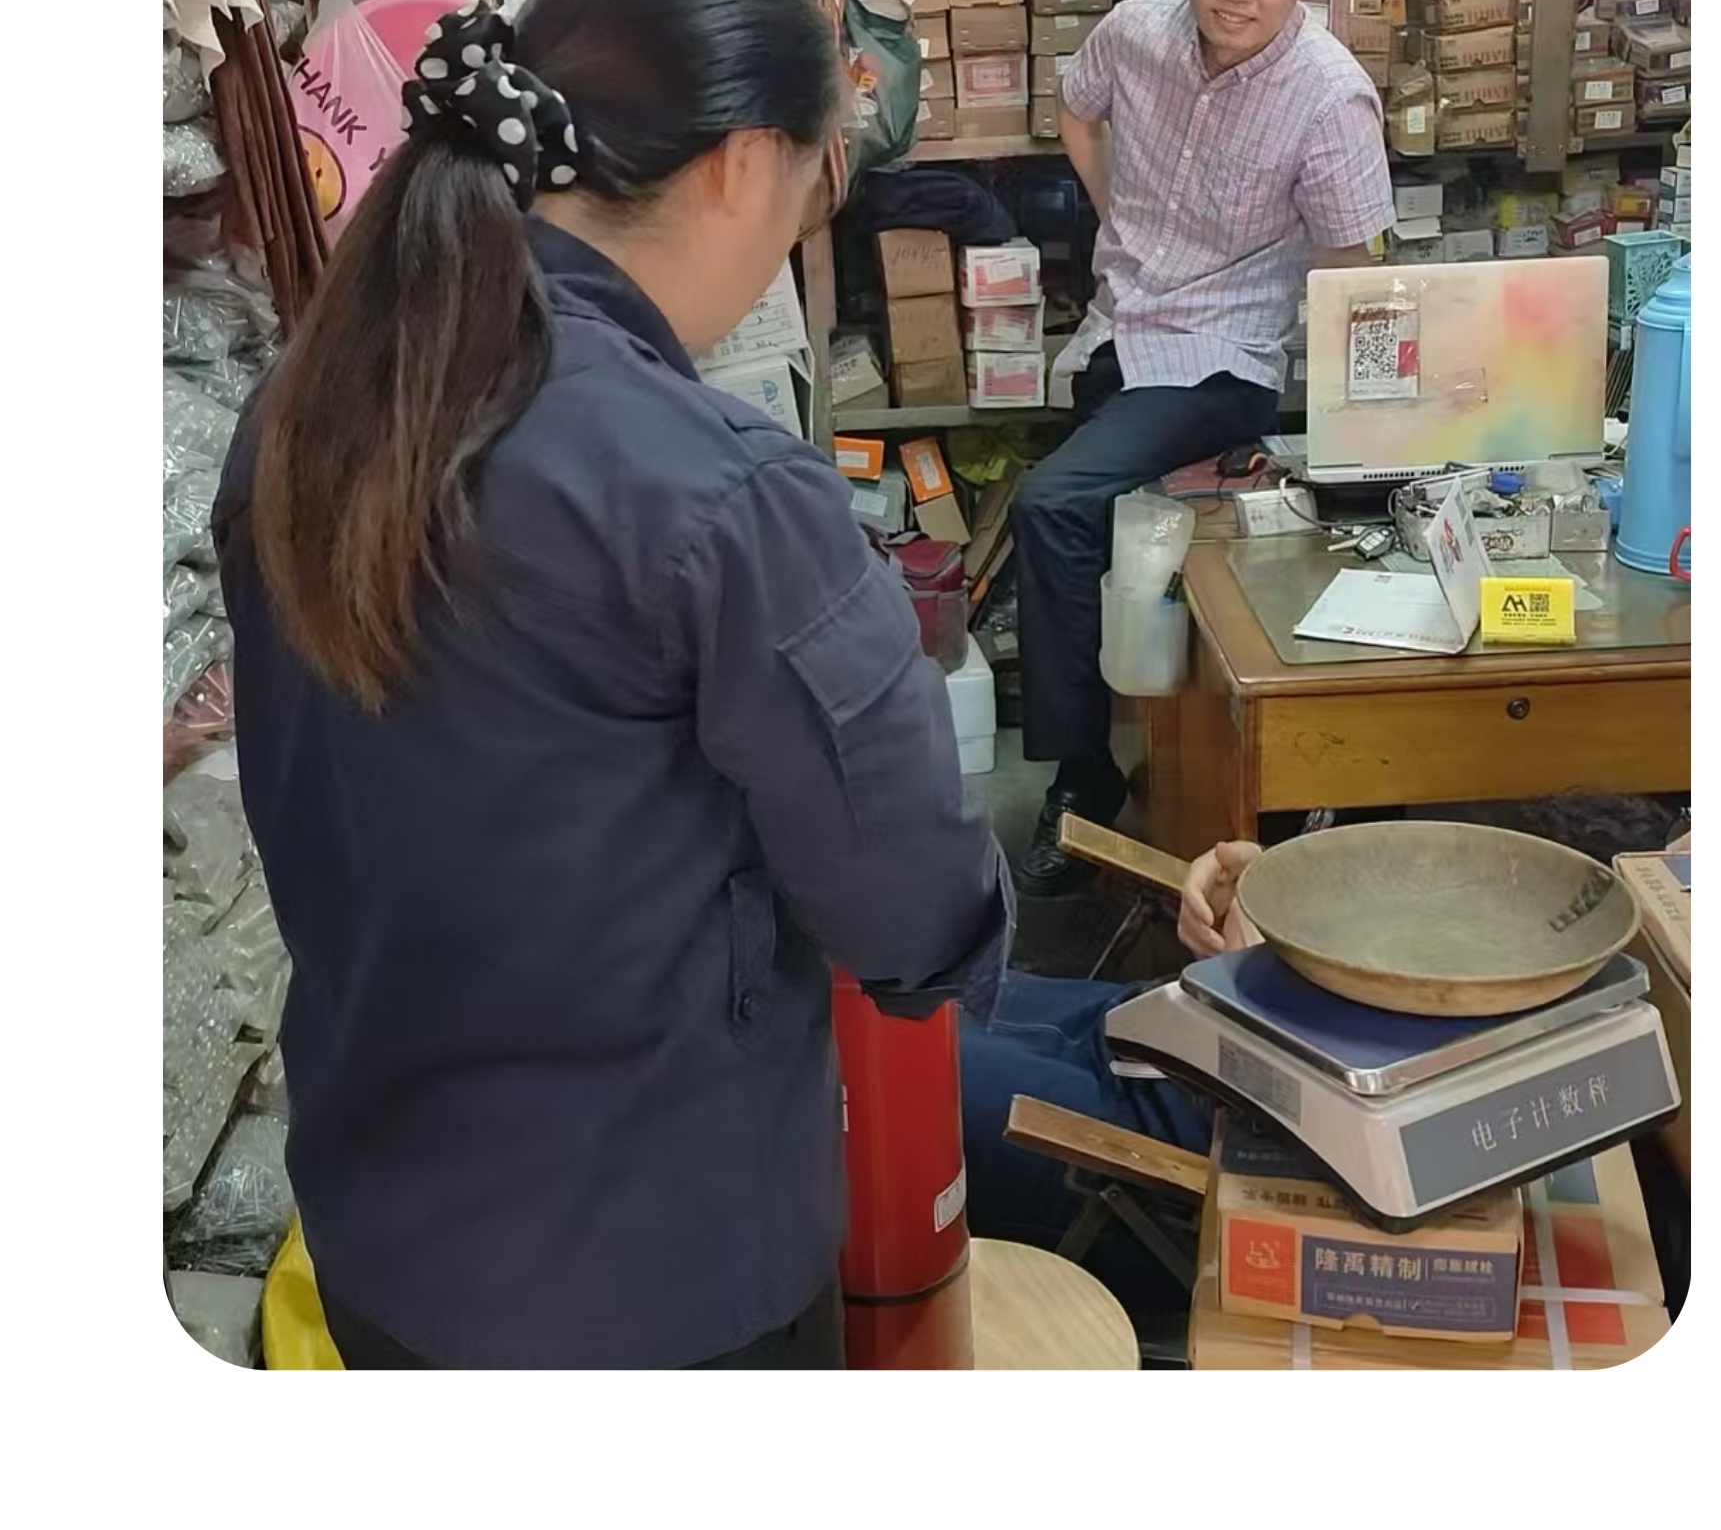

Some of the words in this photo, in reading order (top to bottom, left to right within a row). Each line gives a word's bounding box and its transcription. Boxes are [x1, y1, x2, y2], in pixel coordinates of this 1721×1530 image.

[295, 57, 368, 146] HANK
[1470, 1074, 1610, 1153] 电子计数秤
